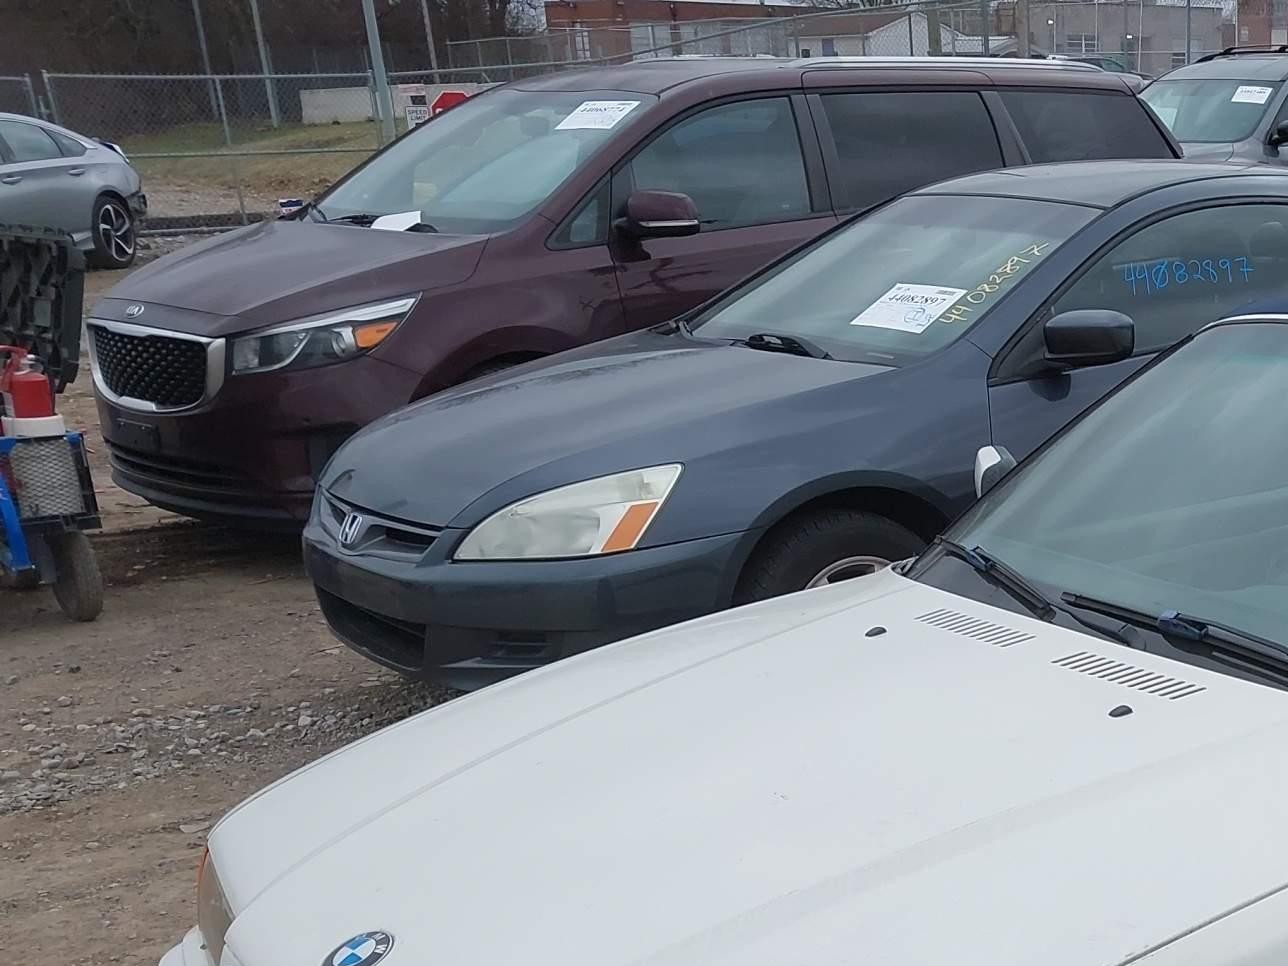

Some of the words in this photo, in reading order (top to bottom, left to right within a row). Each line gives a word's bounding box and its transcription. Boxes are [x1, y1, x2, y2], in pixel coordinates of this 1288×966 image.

[939, 242, 1050, 325] 44082897
[1123, 256, 1256, 297] 44082897
[888, 292, 948, 307] 44082897
